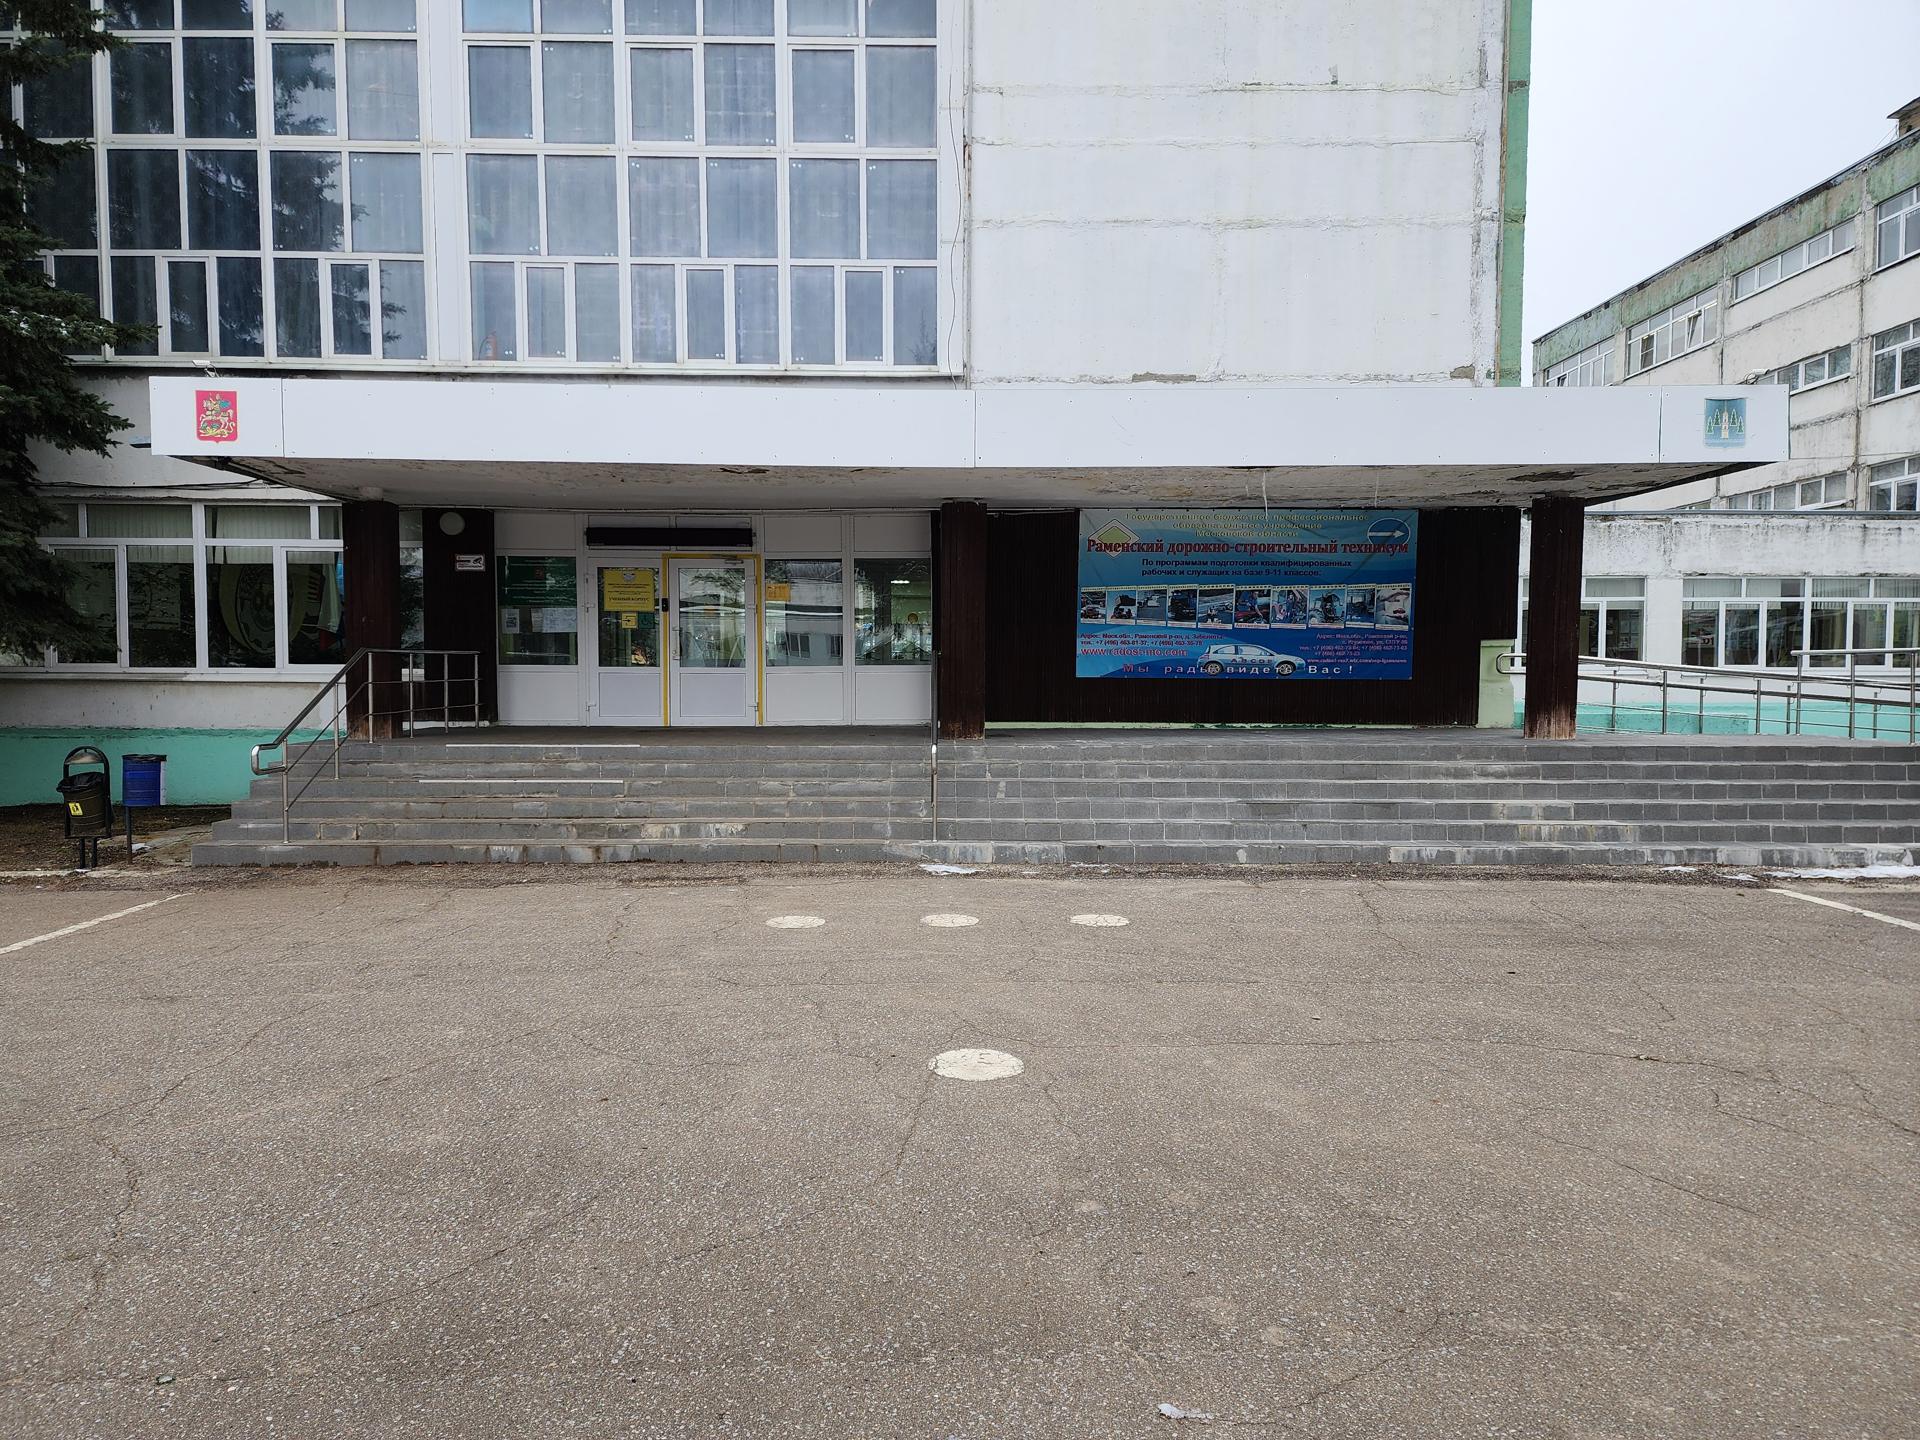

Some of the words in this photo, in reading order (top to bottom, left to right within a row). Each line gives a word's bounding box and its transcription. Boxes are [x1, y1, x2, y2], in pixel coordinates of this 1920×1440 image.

[1087, 539, 1163, 553] Раменский
[1167, 540, 1337, 556] дорожно-строительный
[1341, 543, 1408, 556] техникум
[1142, 558, 1154, 566] По
[1155, 560, 1208, 568] программам
[1210, 560, 1258, 568] подготовки
[1261, 560, 1352, 568] квалифицированных
[1142, 568, 1177, 576] рабочих
[1186, 569, 1229, 577] служащих
[1123, 664, 1149, 673] Мы
[1164, 666, 1212, 674] рады
[1308, 665, 1341, 673] Вас
